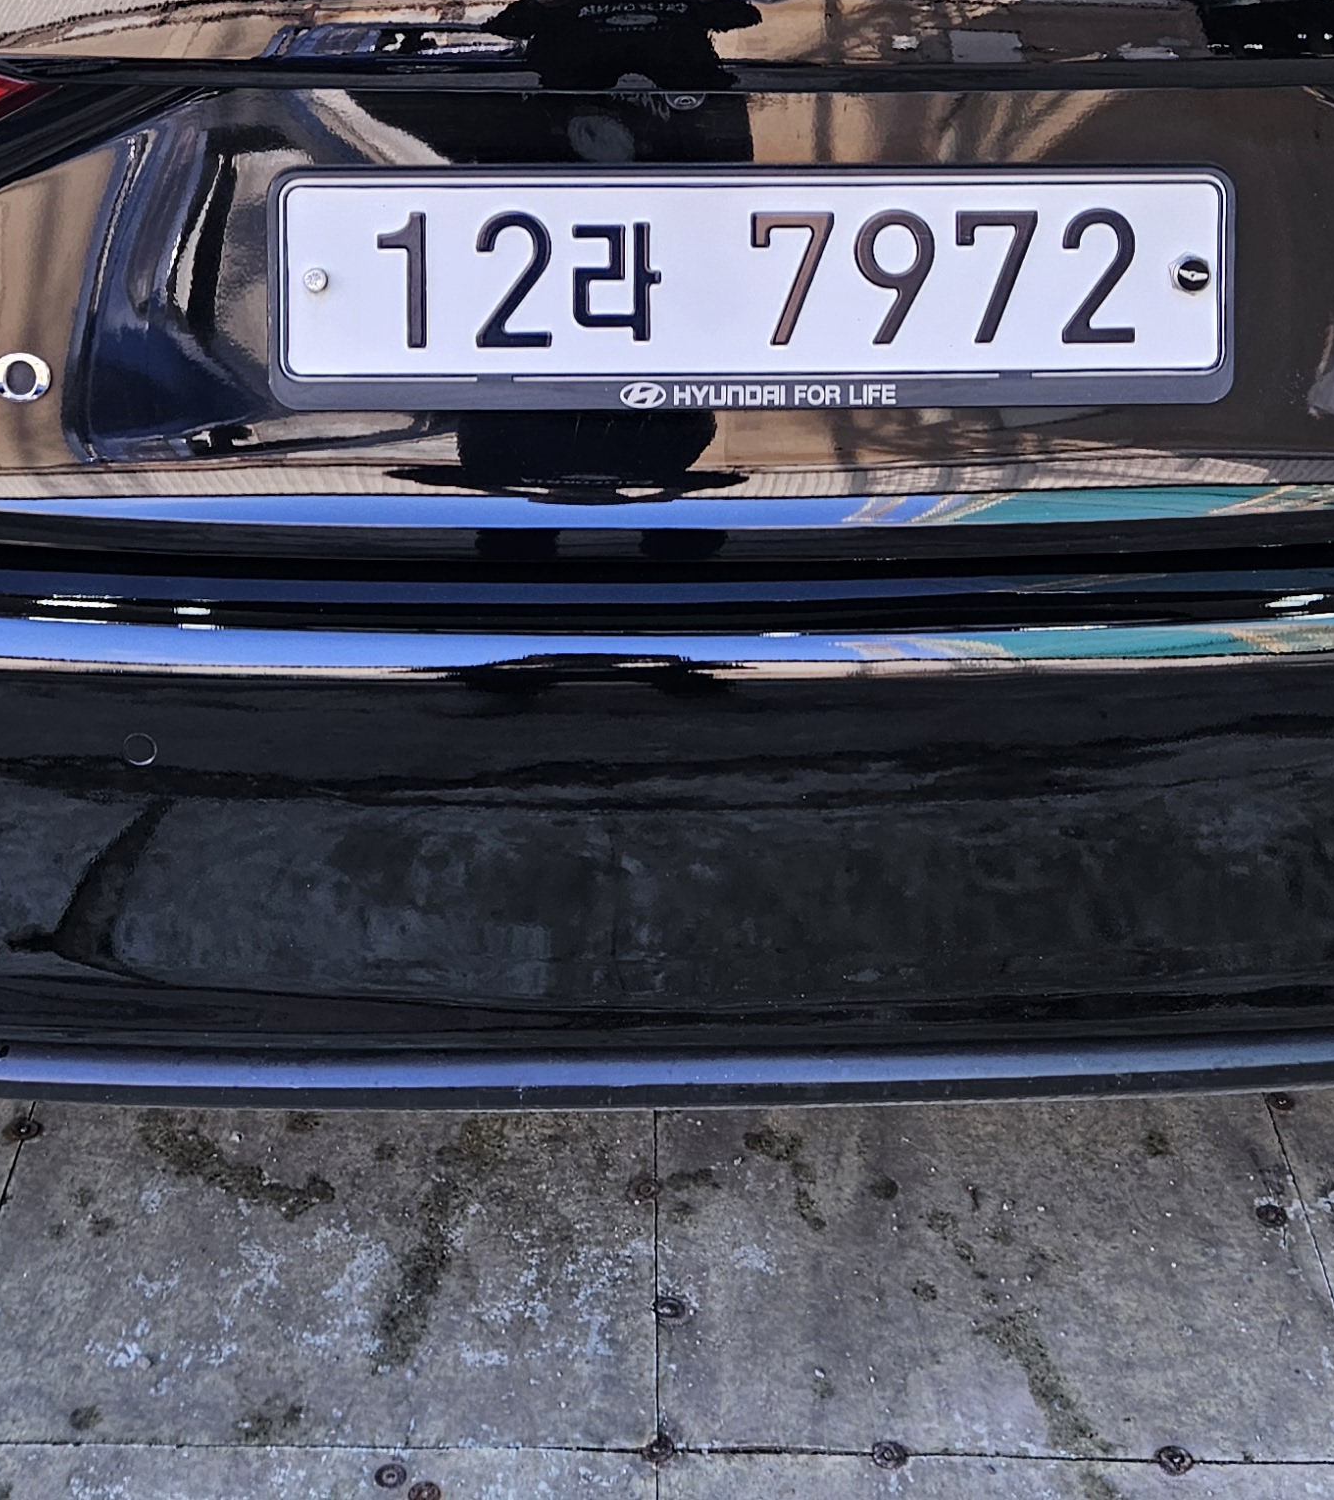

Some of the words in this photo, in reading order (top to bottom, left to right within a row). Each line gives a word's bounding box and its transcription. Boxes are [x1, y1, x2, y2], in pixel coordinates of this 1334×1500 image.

[376, 211, 663, 349] 12라
[750, 210, 1137, 347] 7972
[673, 384, 786, 406] HYUNDAI
[794, 384, 841, 406] FOR
[849, 383, 897, 406] LIFE
